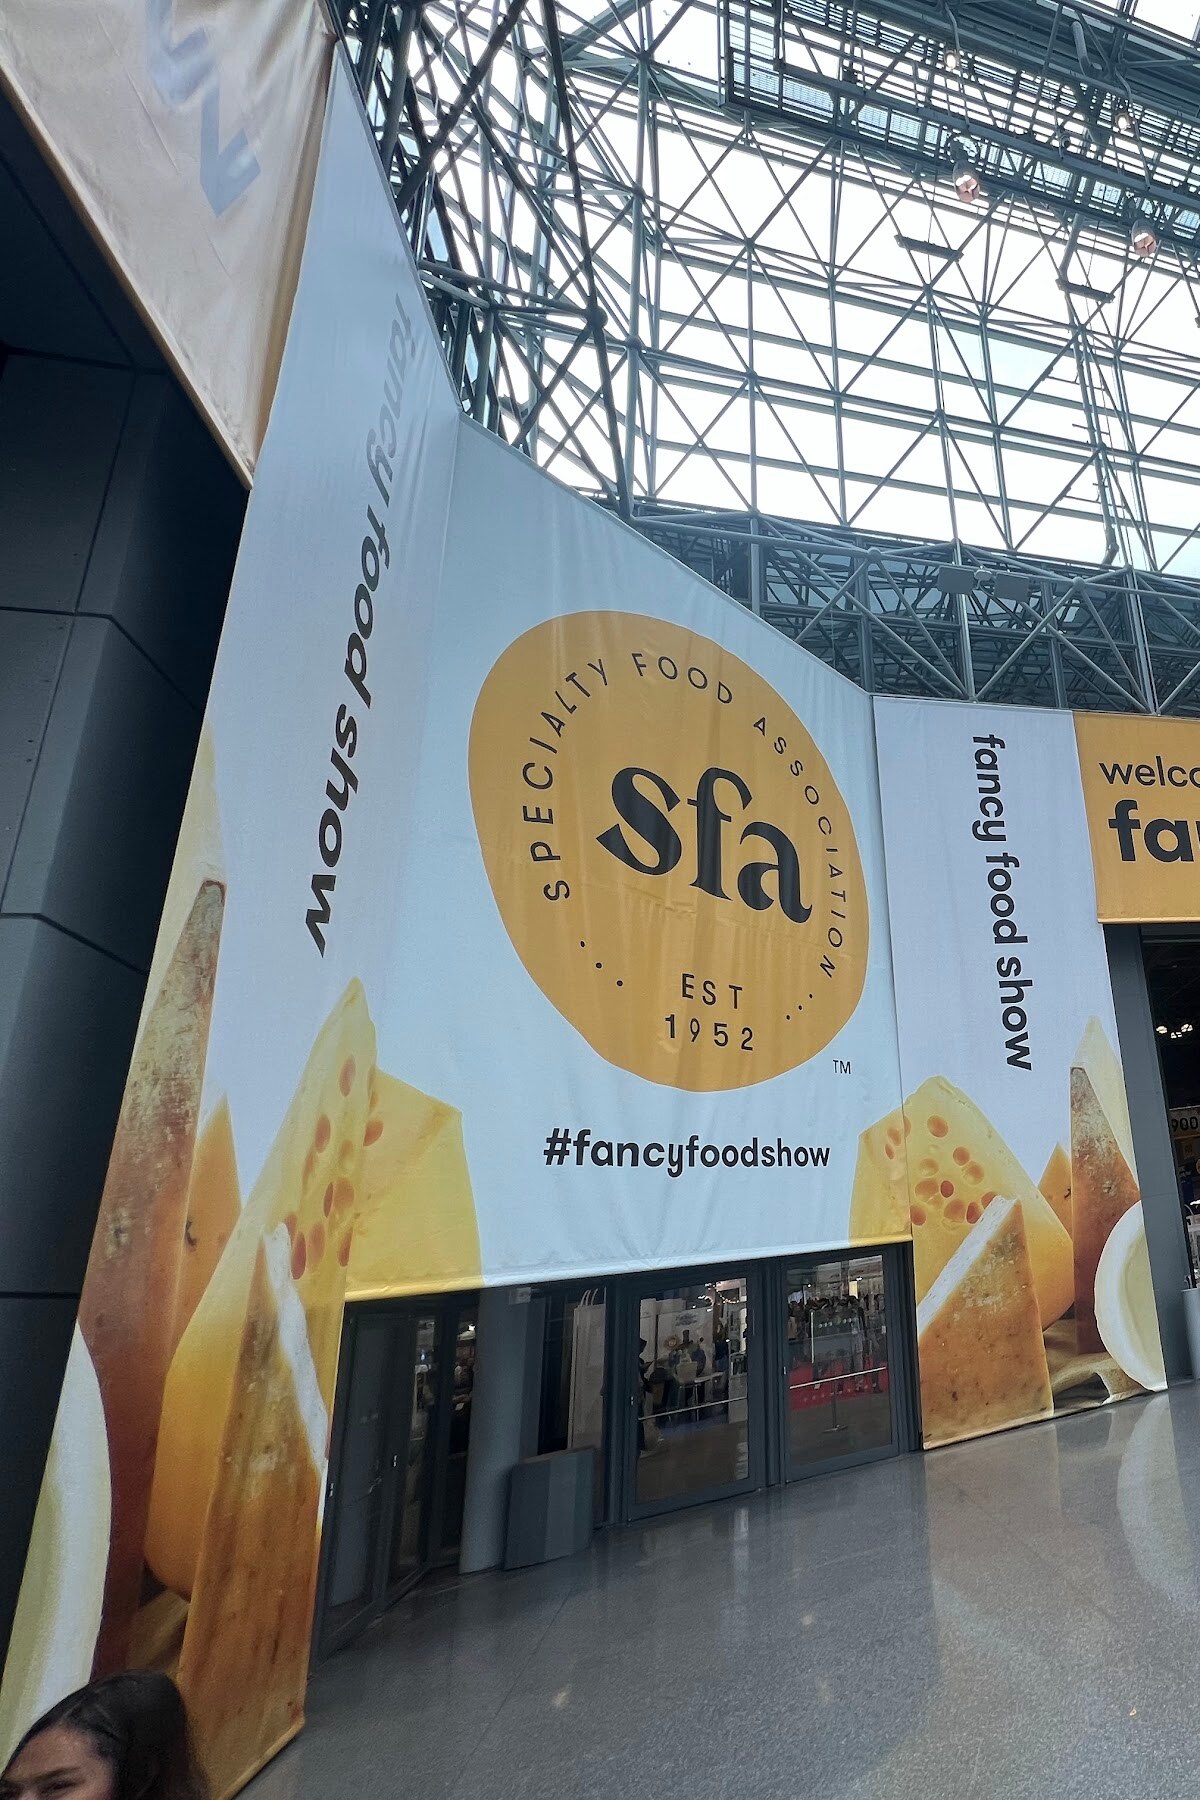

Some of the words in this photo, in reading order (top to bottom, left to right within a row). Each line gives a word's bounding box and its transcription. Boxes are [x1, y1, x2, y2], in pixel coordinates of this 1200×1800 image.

[366, 293, 416, 508] fancy
[345, 504, 390, 709] food
[305, 703, 359, 958] show
[522, 658, 608, 901] SPECIALTY
[631, 652, 733, 704] FOOD
[753, 716, 847, 978] ASSOCIATION
[596, 767, 813, 923] sfa
[972, 733, 1007, 842] fancy
[986, 852, 1029, 944] food
[664, 1014, 754, 1052] 1952
[681, 973, 743, 1010] EST
[996, 955, 1034, 1072] show
[543, 1127, 830, 1178] #fancyfoodshow
